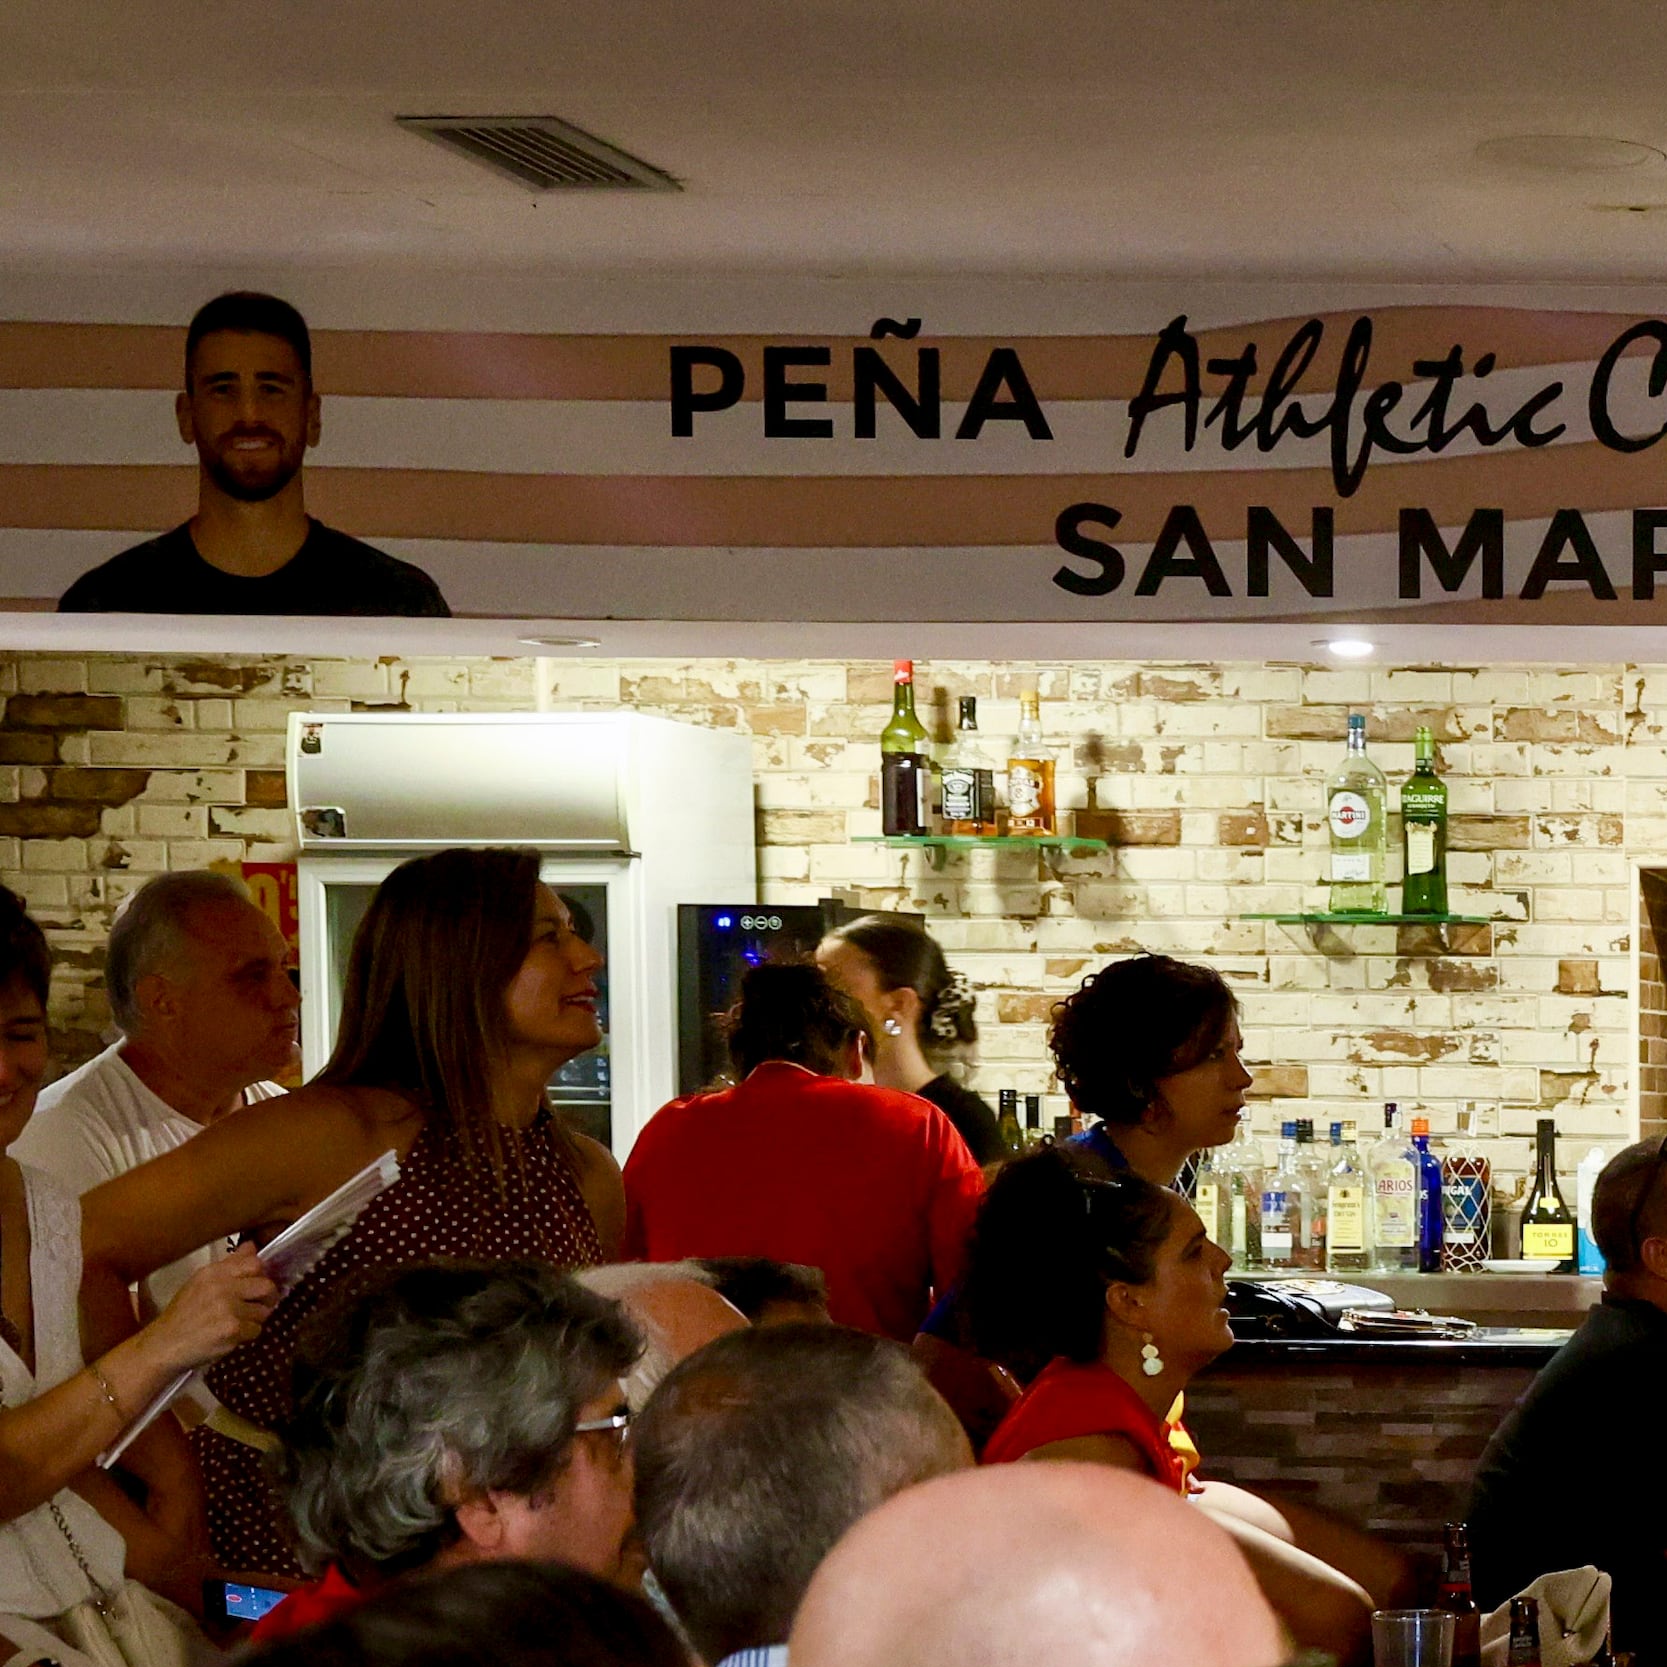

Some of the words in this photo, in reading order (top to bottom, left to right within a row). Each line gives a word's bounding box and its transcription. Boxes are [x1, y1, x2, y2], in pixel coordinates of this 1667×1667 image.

[669, 318, 1054, 441] PEÑA
[1124, 315, 1567, 499] Athletic
[1052, 502, 1334, 598] SAN
[1544, 1239, 1558, 1248] 10
